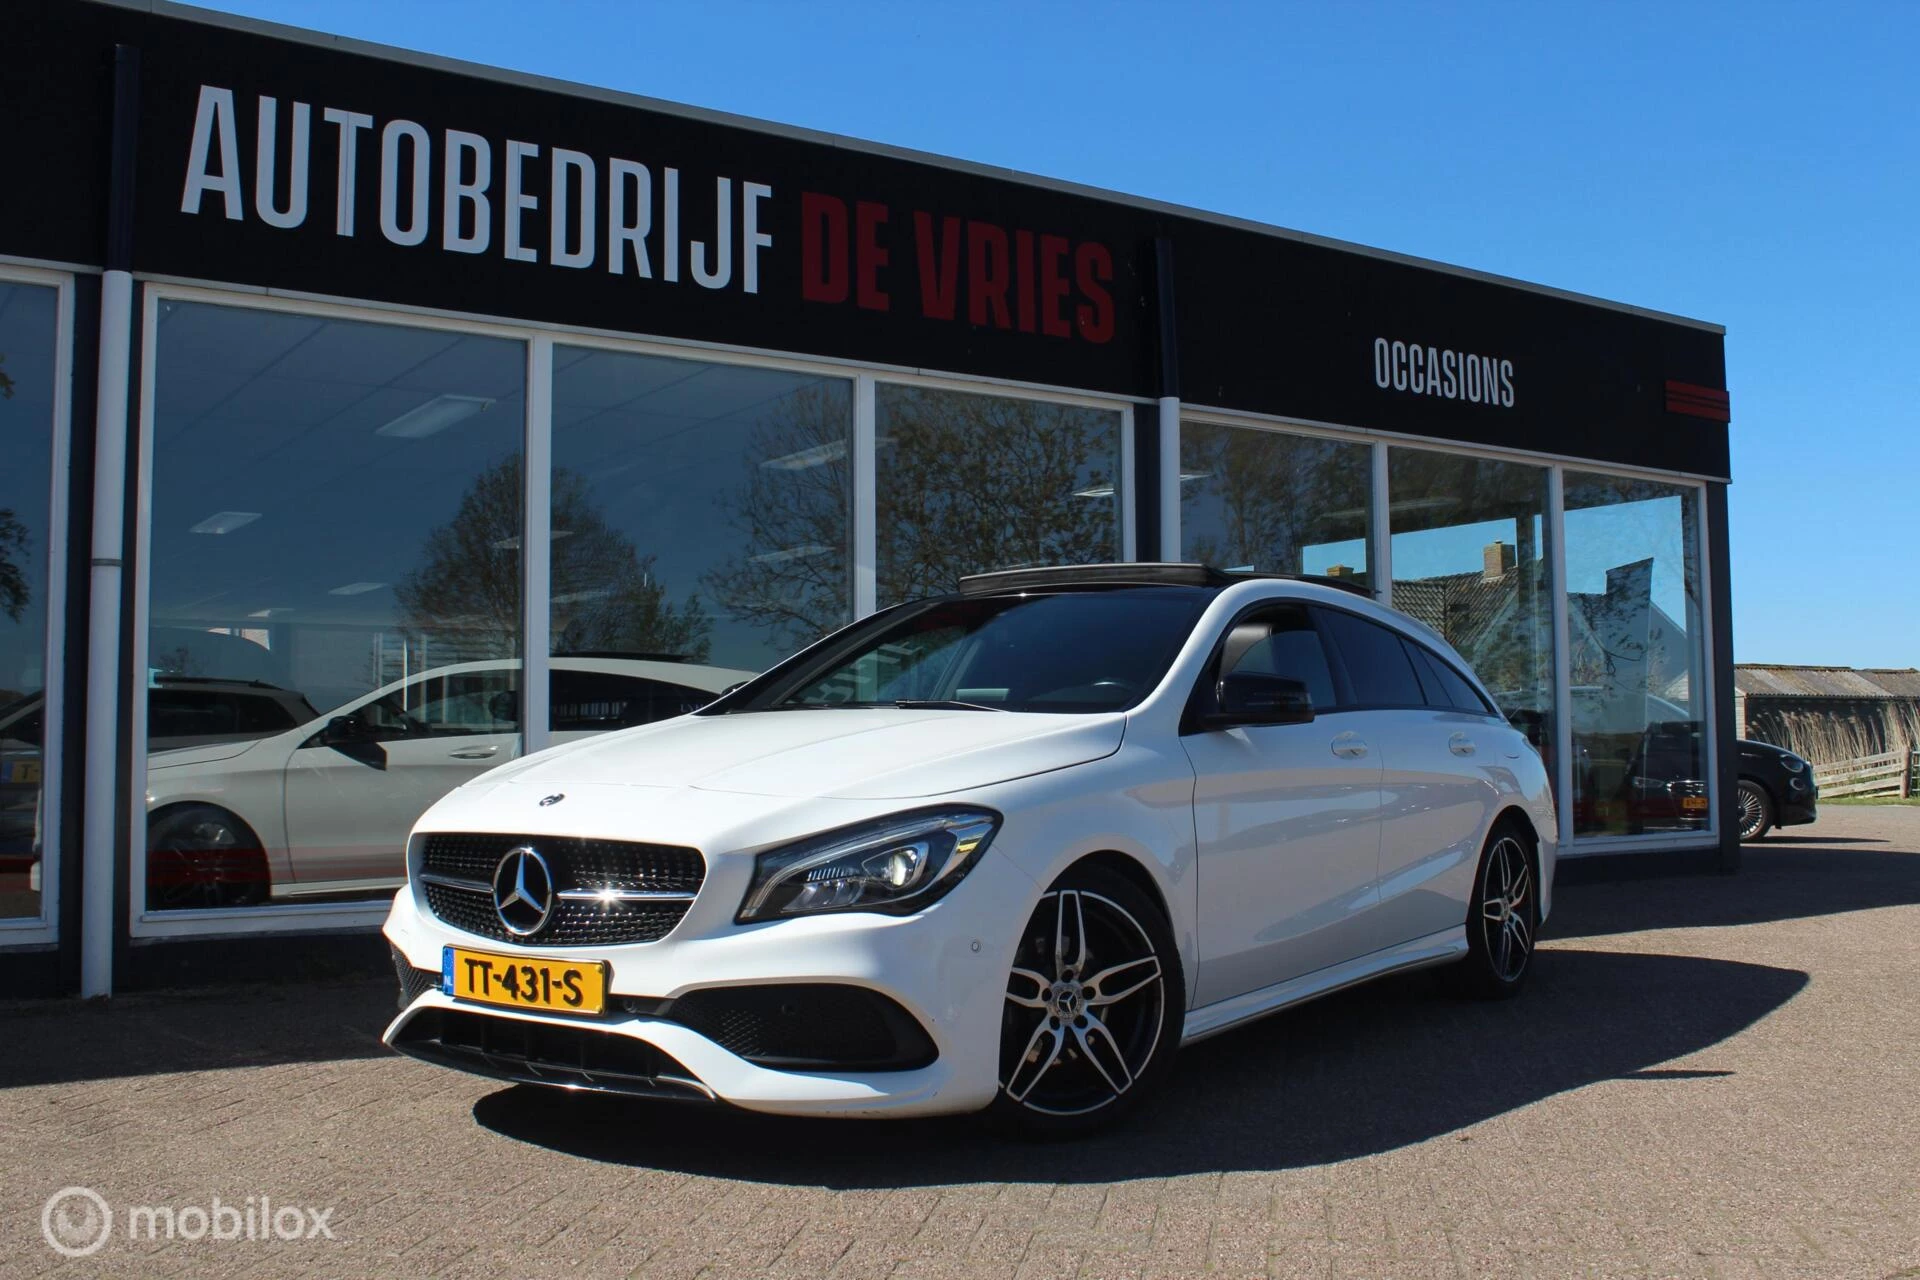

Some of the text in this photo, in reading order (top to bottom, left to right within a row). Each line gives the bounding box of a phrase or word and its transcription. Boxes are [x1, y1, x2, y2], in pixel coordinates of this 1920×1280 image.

[181, 84, 1115, 344] AUTOBEDRIJF DE VRIES
[1374, 337, 1515, 408] OCCASIONS
[443, 958, 583, 1007] NL TT-431-S
